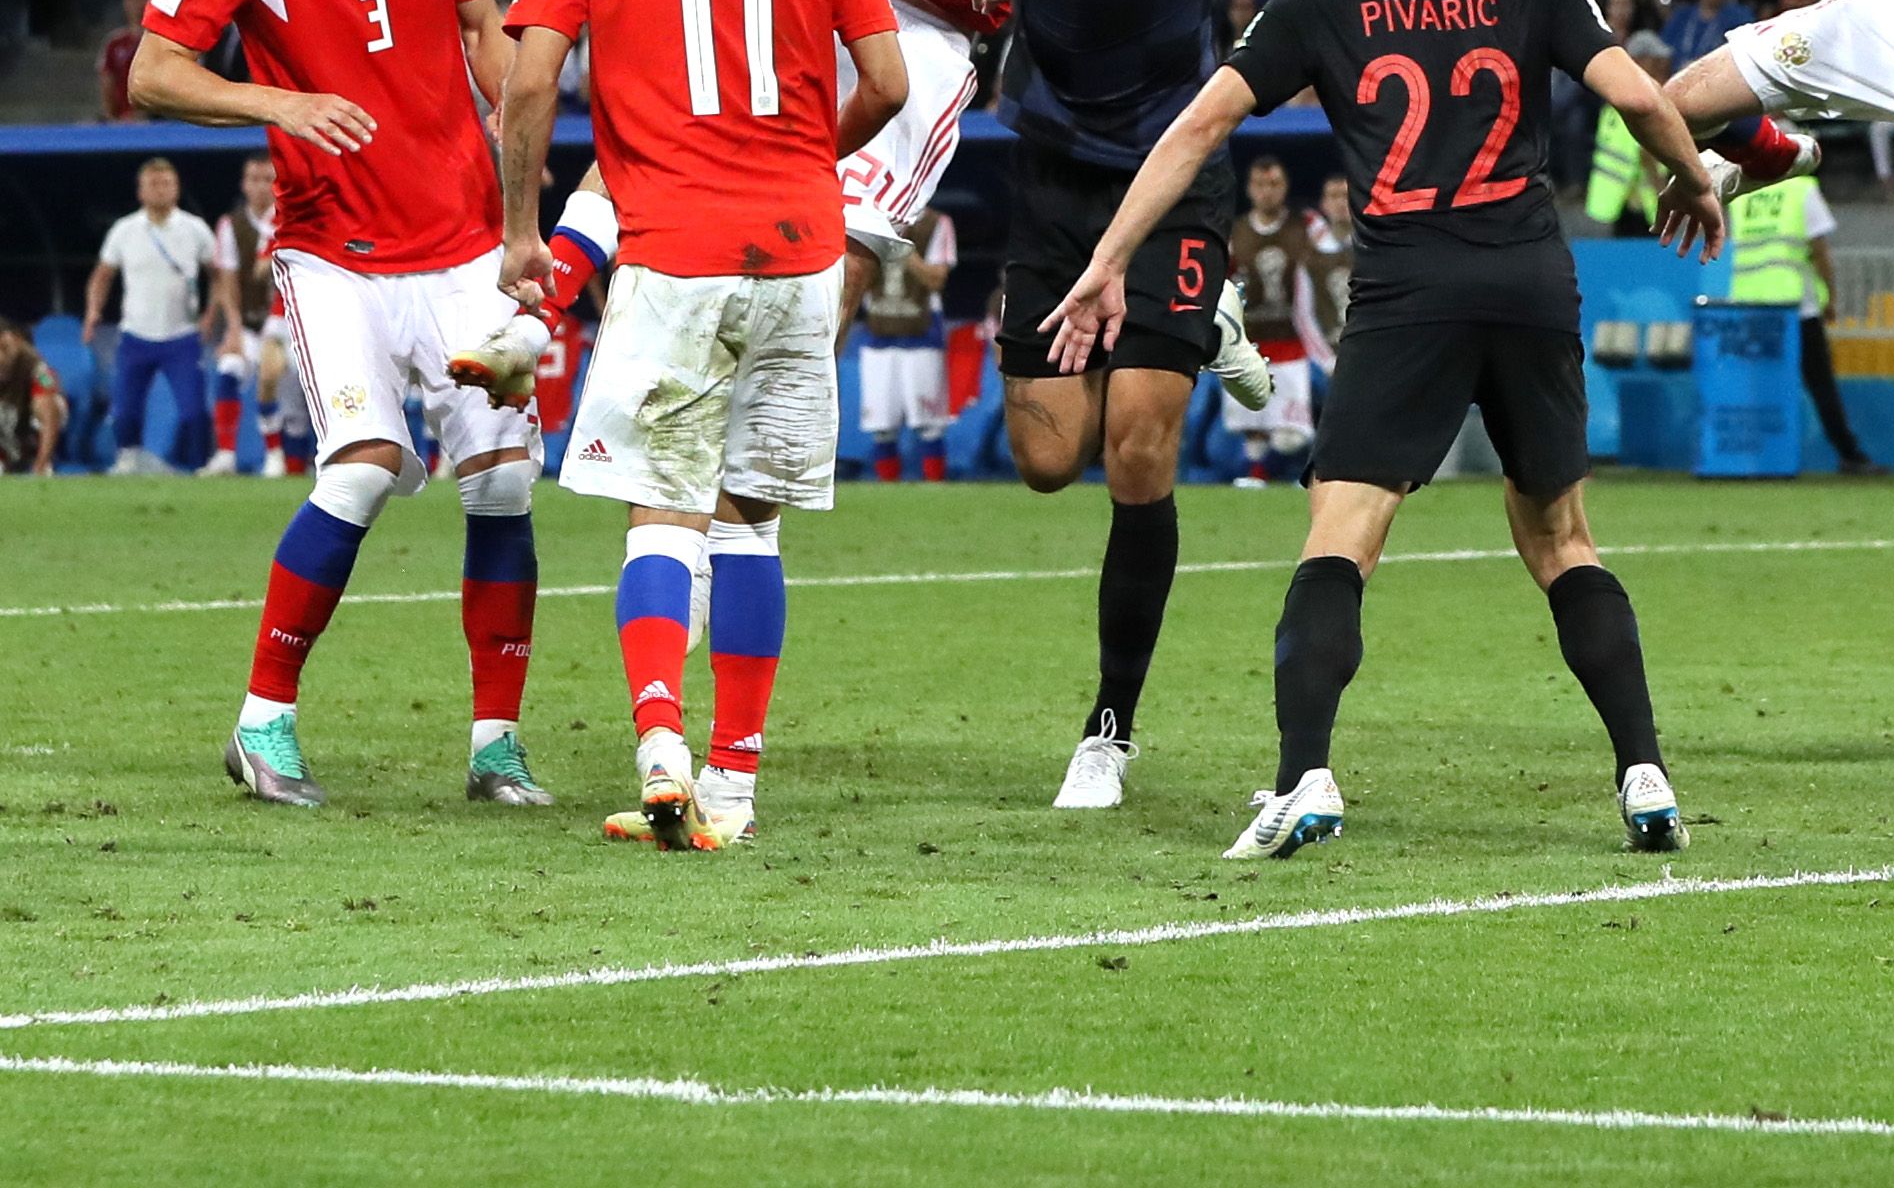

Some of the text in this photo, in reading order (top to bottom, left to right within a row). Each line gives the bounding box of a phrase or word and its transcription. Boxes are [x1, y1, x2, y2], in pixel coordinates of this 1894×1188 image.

[1355, 46, 1529, 217] 22
[1177, 237, 1206, 298] 5
[578, 452, 613, 463] adidas
